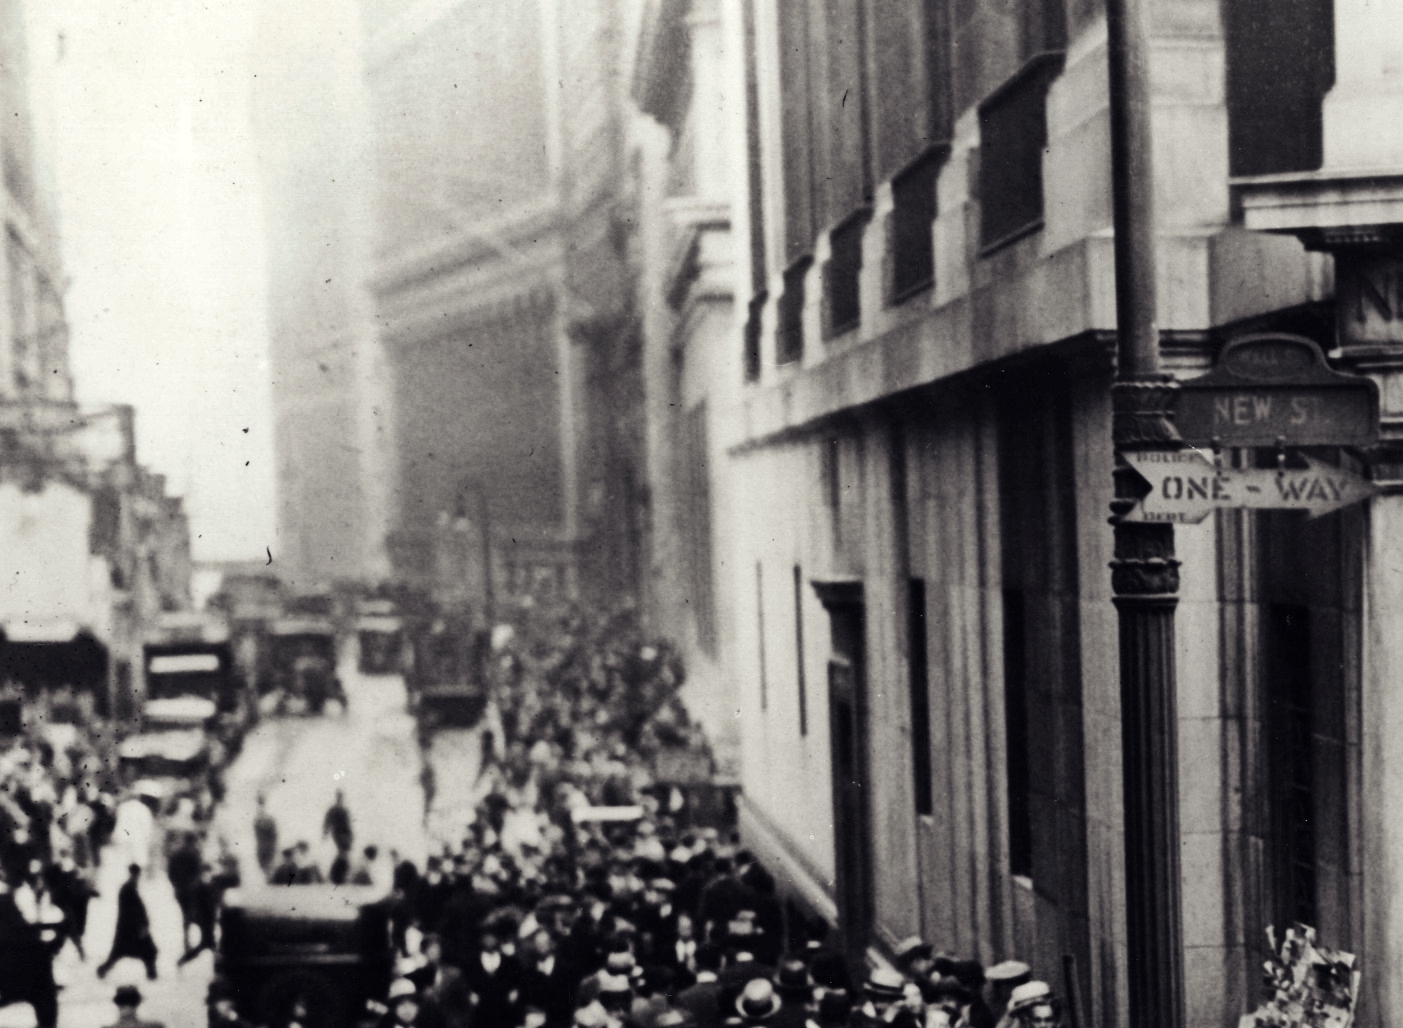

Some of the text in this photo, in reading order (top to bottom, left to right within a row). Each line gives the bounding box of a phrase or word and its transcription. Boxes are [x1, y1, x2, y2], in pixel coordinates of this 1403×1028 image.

[1213, 395, 1271, 425] NEW
[1162, 476, 1231, 500] ONE
[1275, 477, 1347, 501] WAY
